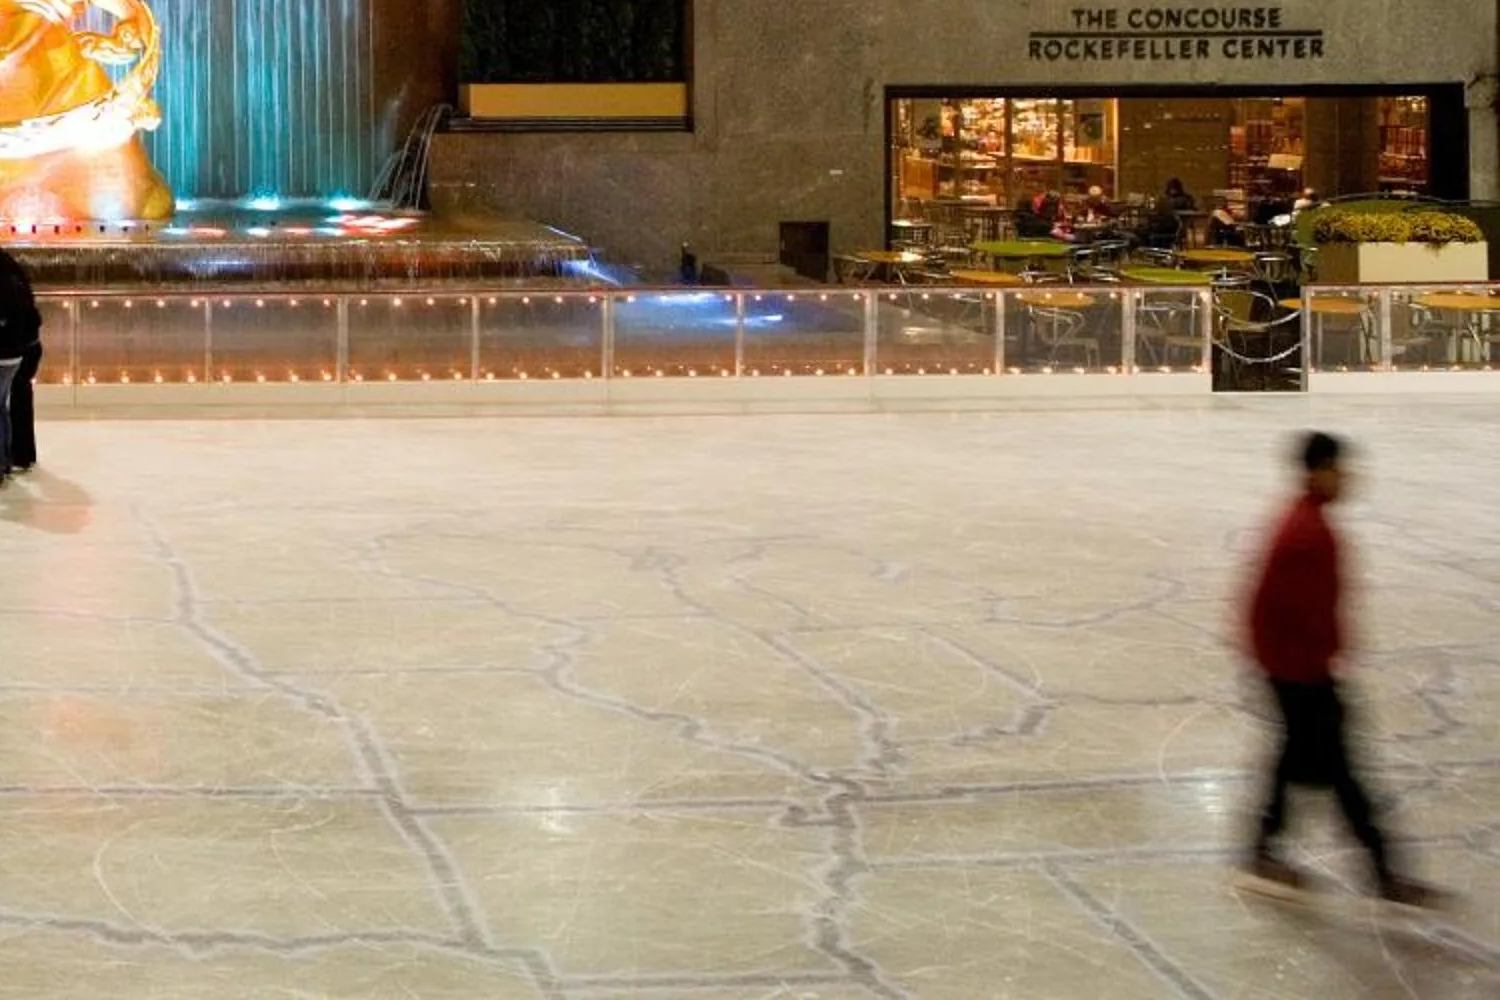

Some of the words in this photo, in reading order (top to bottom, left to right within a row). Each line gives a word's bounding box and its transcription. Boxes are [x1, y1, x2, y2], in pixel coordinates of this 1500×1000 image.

[1071, 8, 1118, 29] THE
[1128, 7, 1283, 29] CONCOURSE
[1028, 39, 1210, 60] ROCKEFELLER
[1222, 38, 1324, 59] CENTER
